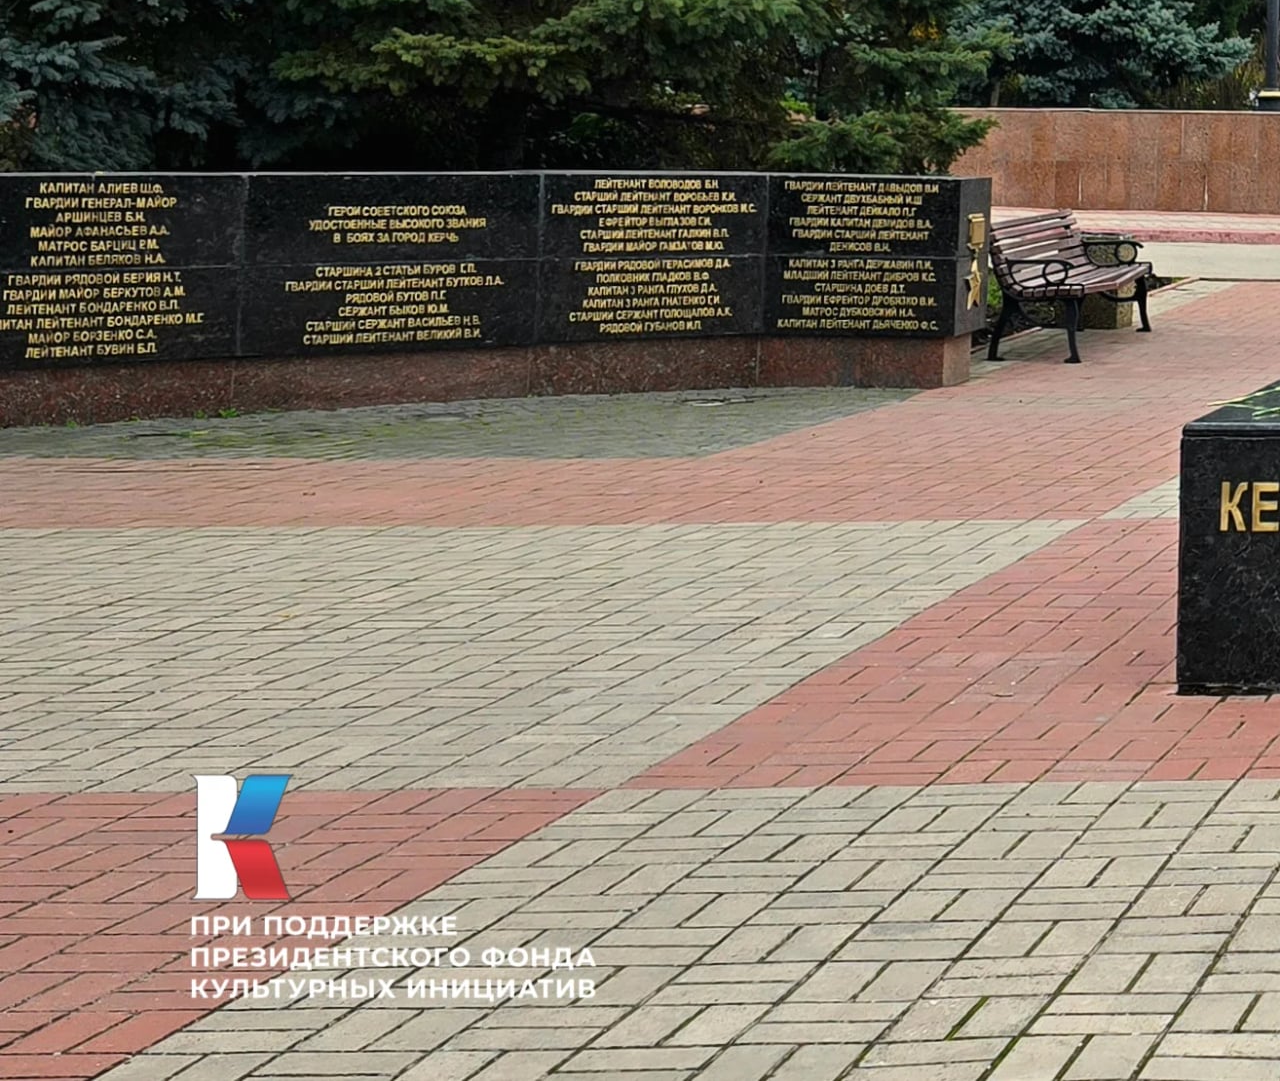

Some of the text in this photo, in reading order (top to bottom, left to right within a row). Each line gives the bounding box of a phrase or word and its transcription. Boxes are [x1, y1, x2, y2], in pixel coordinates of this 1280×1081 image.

[40, 183, 94, 194] КАПИТАН
[98, 182, 138, 193] АЛИЕВ
[25, 197, 177, 209] ГВАРДИИ ГЕНЕРАЛ-МАЙОР
[56, 212, 121, 223] АРШИНЦЕВ
[328, 205, 466, 217] ГЕРОИ СОВЕТСКОГО СОЮЗА
[309, 219, 387, 231] УДОСТОЕННЫЕ
[447, 218, 486, 229] ЗВАНИЯ
[31, 227, 71, 237] МАЙОР
[76, 226, 147, 236] АФАНАСЬЕВ
[347, 233, 374, 242] БОЯХ
[377, 233, 390, 242] ЗА
[392, 231, 425, 242] ГОРОД
[428, 232, 458, 242] КЕРЧЬ
[38, 240, 87, 252] МАТРОС
[90, 240, 136, 252] БАРЦИЦ
[31, 255, 85, 266] КАПИТАН
[89, 254, 141, 265] БЕЛЯКОВ
[316, 266, 373, 277] СТАРШИНА
[383, 264, 420, 276] СТАТЬИ
[9, 274, 61, 286] ГВАРДИИ
[65, 273, 119, 285] РЯДОВОЙ
[123, 272, 160, 284] БЕРИЯ
[285, 281, 332, 292] ГВАРДИИ
[334, 280, 384, 290] СТАРШИЙ
[386, 277, 443, 288] ЛЕЙТЕНАНТ
[3, 289, 56, 301] ГВАРДИИ
[59, 288, 99, 299] МАЙОР
[103, 287, 160, 299] БЕРКУТОВ
[346, 292, 394, 304] РЯДОВОЙ
[7, 303, 76, 315] ЛЕЙТЕНАНТ
[80, 301, 156, 313] БОНДАРЕНКО
[338, 306, 386, 316] СЕРЖАНТ
[36, 317, 103, 329] ЛЕЙТЕНАНТ
[107, 313, 183, 326] БОНДАРЕНКО
[306, 320, 355, 332] СТАРШИЙ
[358, 317, 405, 329] СЕРЖАНТ
[29, 332, 70, 343] МАЙОР
[73, 330, 133, 342] БОРЗЕНКО
[303, 333, 352, 345] СТАРШИЙ
[355, 331, 414, 342] ЛЕЙТЕНАНТ
[25, 345, 94, 358] ЛЕЙТЕНАНТ
[97, 344, 134, 355] БУВИН
